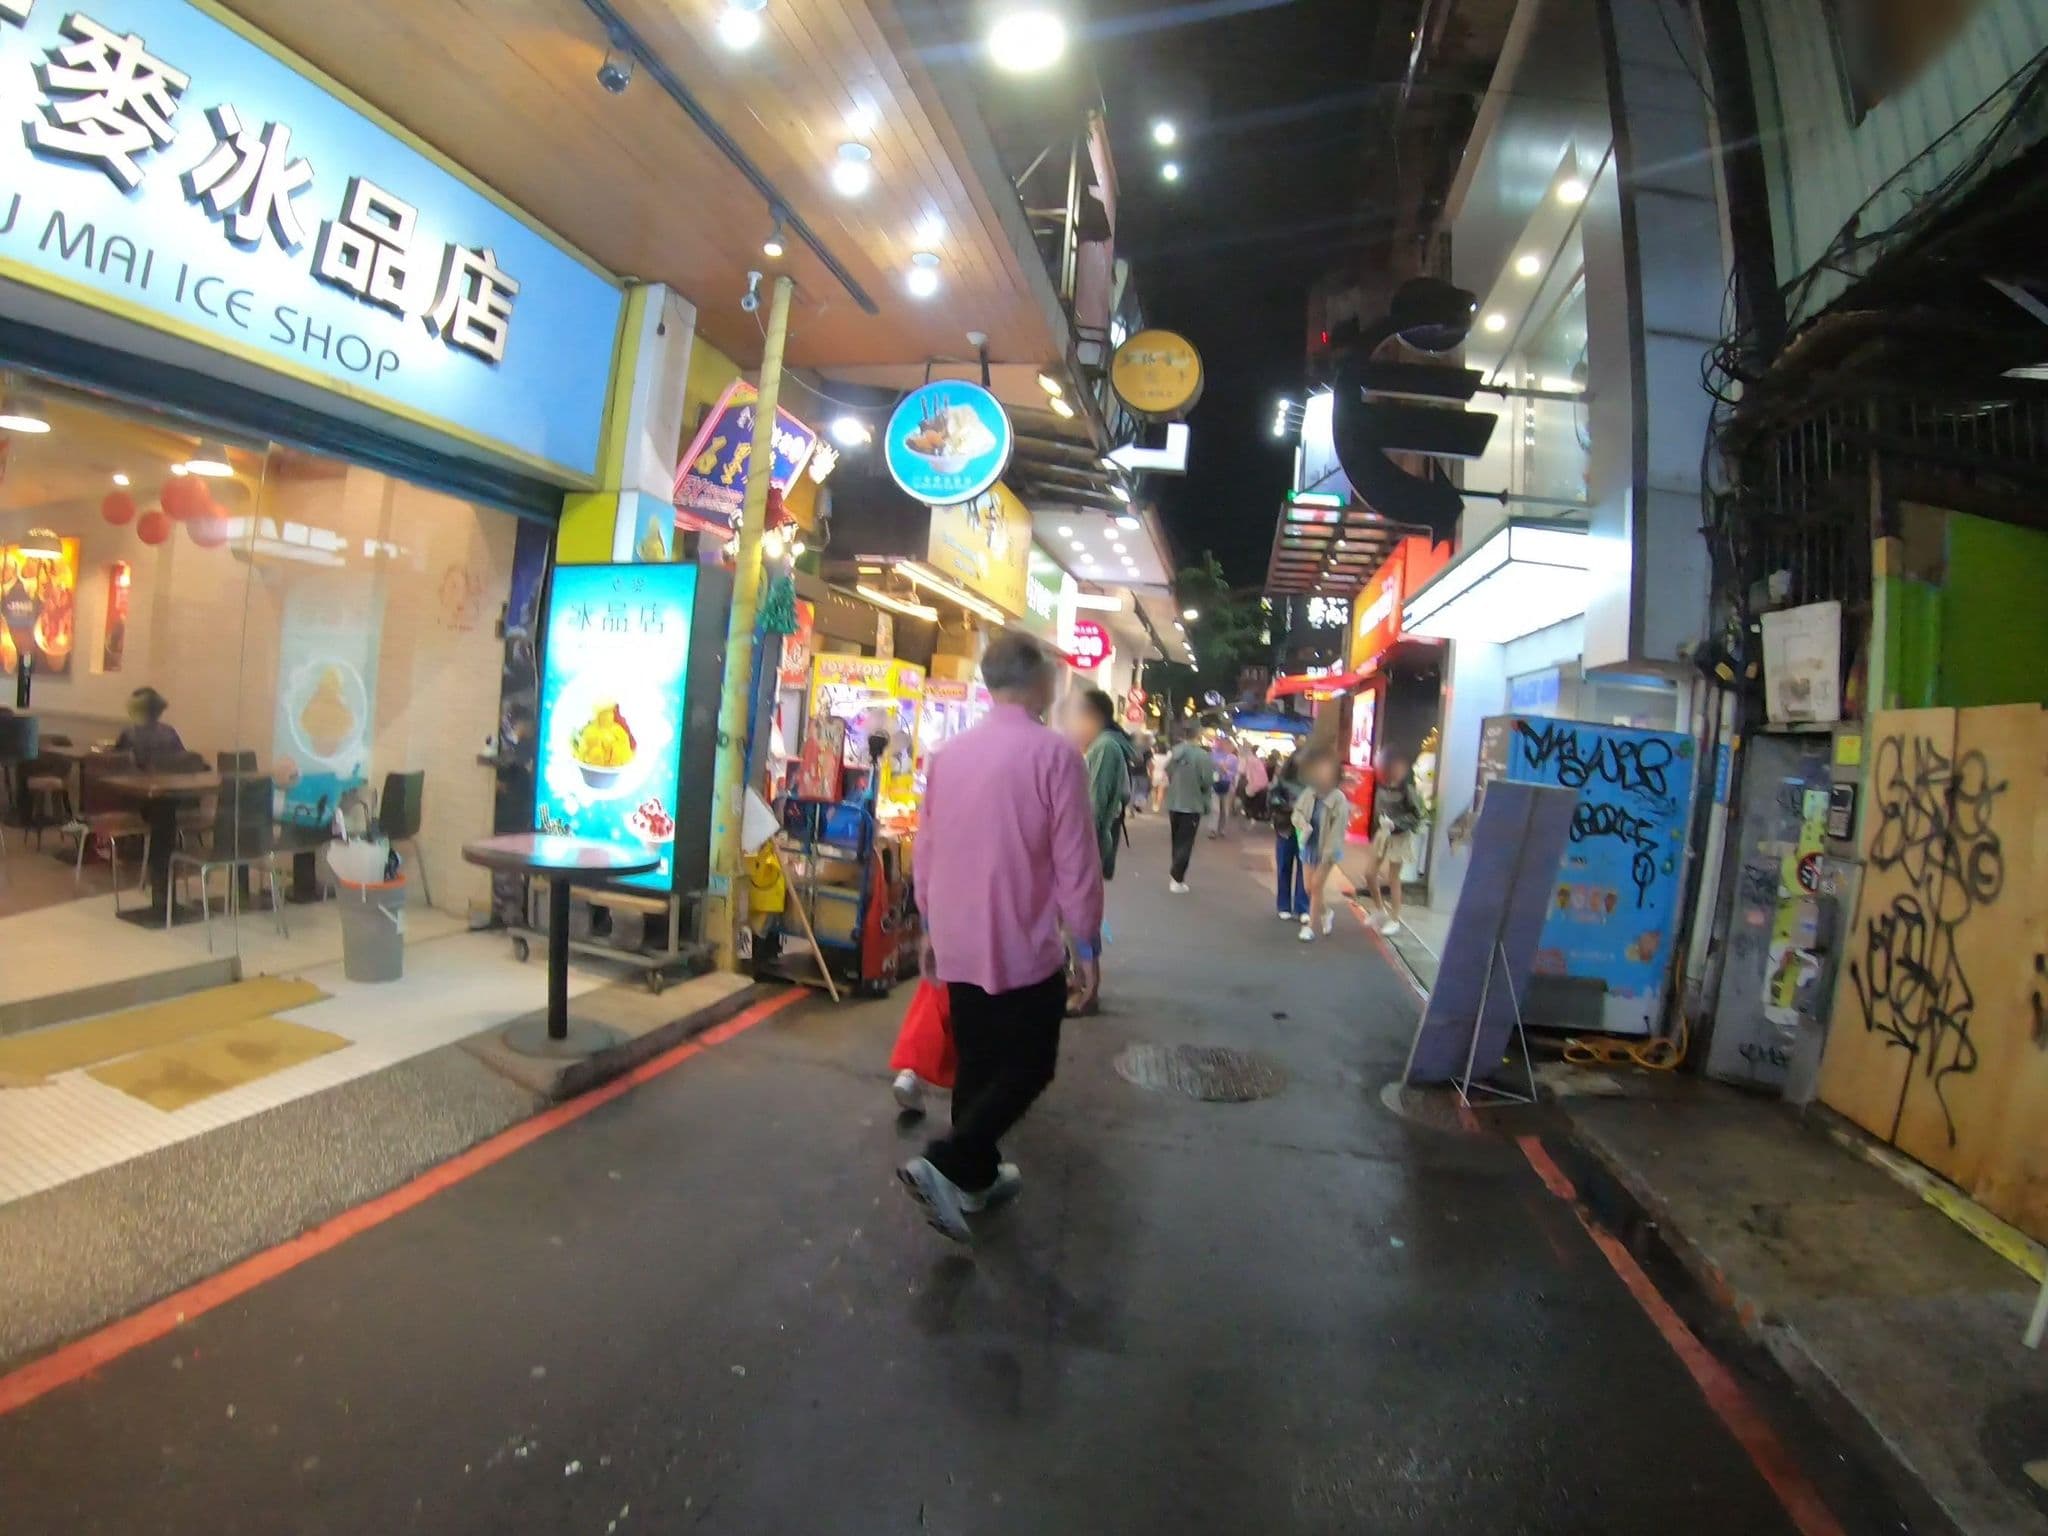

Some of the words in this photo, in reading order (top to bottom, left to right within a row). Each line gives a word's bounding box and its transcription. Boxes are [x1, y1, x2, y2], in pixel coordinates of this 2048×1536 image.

[0, 0, 520, 365] 麥冰品店
[38, 210, 154, 290] MAI
[175, 263, 255, 329] ICE
[269, 305, 400, 381] SHOP
[848, 663, 888, 678] STORY
